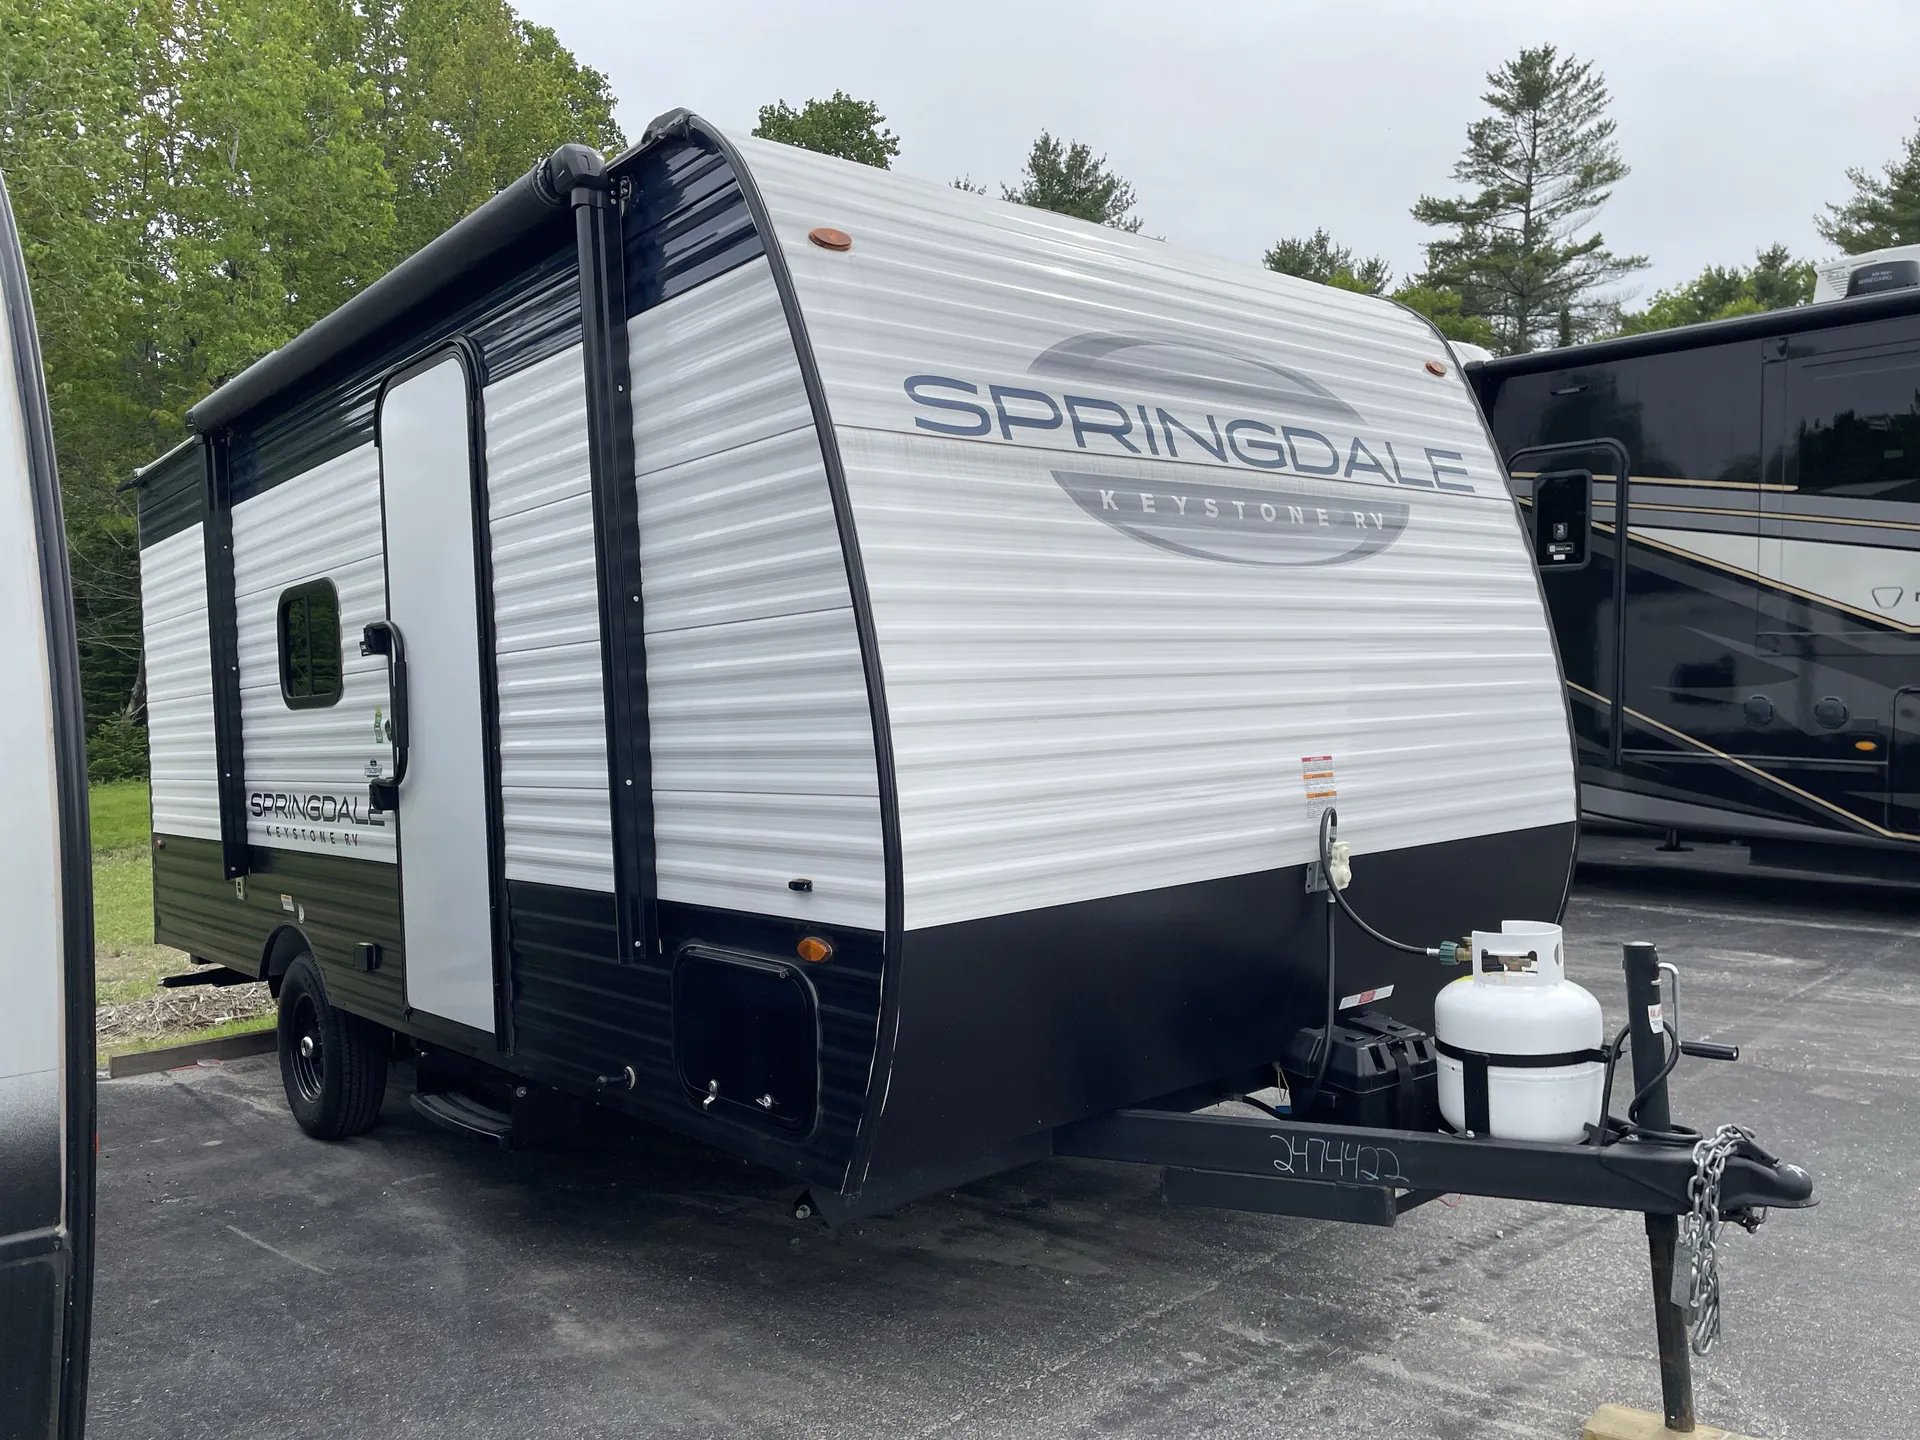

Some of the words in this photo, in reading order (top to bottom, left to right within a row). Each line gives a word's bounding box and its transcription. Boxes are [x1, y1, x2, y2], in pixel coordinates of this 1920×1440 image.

[904, 374, 1475, 492] SPRINGDALE
[1101, 489, 1330, 527] KEYSTONE
[1354, 511, 1384, 529] RV
[251, 793, 385, 826] SPRINGDALE
[266, 825, 335, 845] KEYSTONE
[345, 833, 358, 846] RV
[1270, 1134, 1409, 1182] 2474422
